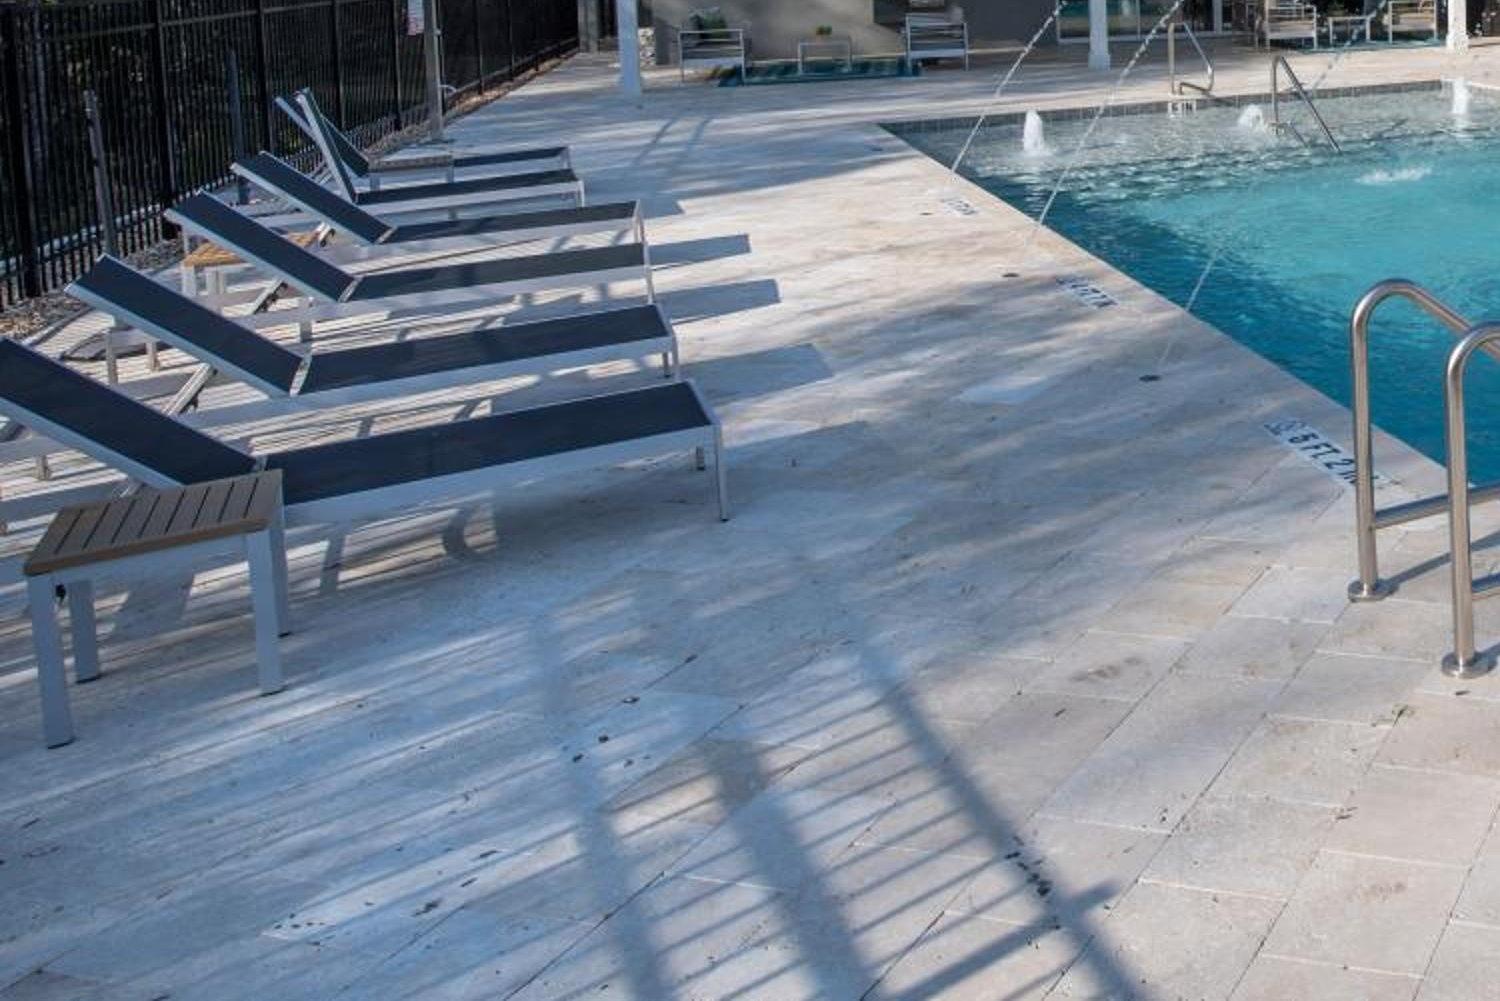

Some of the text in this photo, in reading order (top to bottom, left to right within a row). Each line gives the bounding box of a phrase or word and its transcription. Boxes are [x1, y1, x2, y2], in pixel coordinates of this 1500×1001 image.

[1288, 432, 1320, 444] 5
[1300, 442, 1342, 459] FT
[1323, 458, 1355, 469] 2
